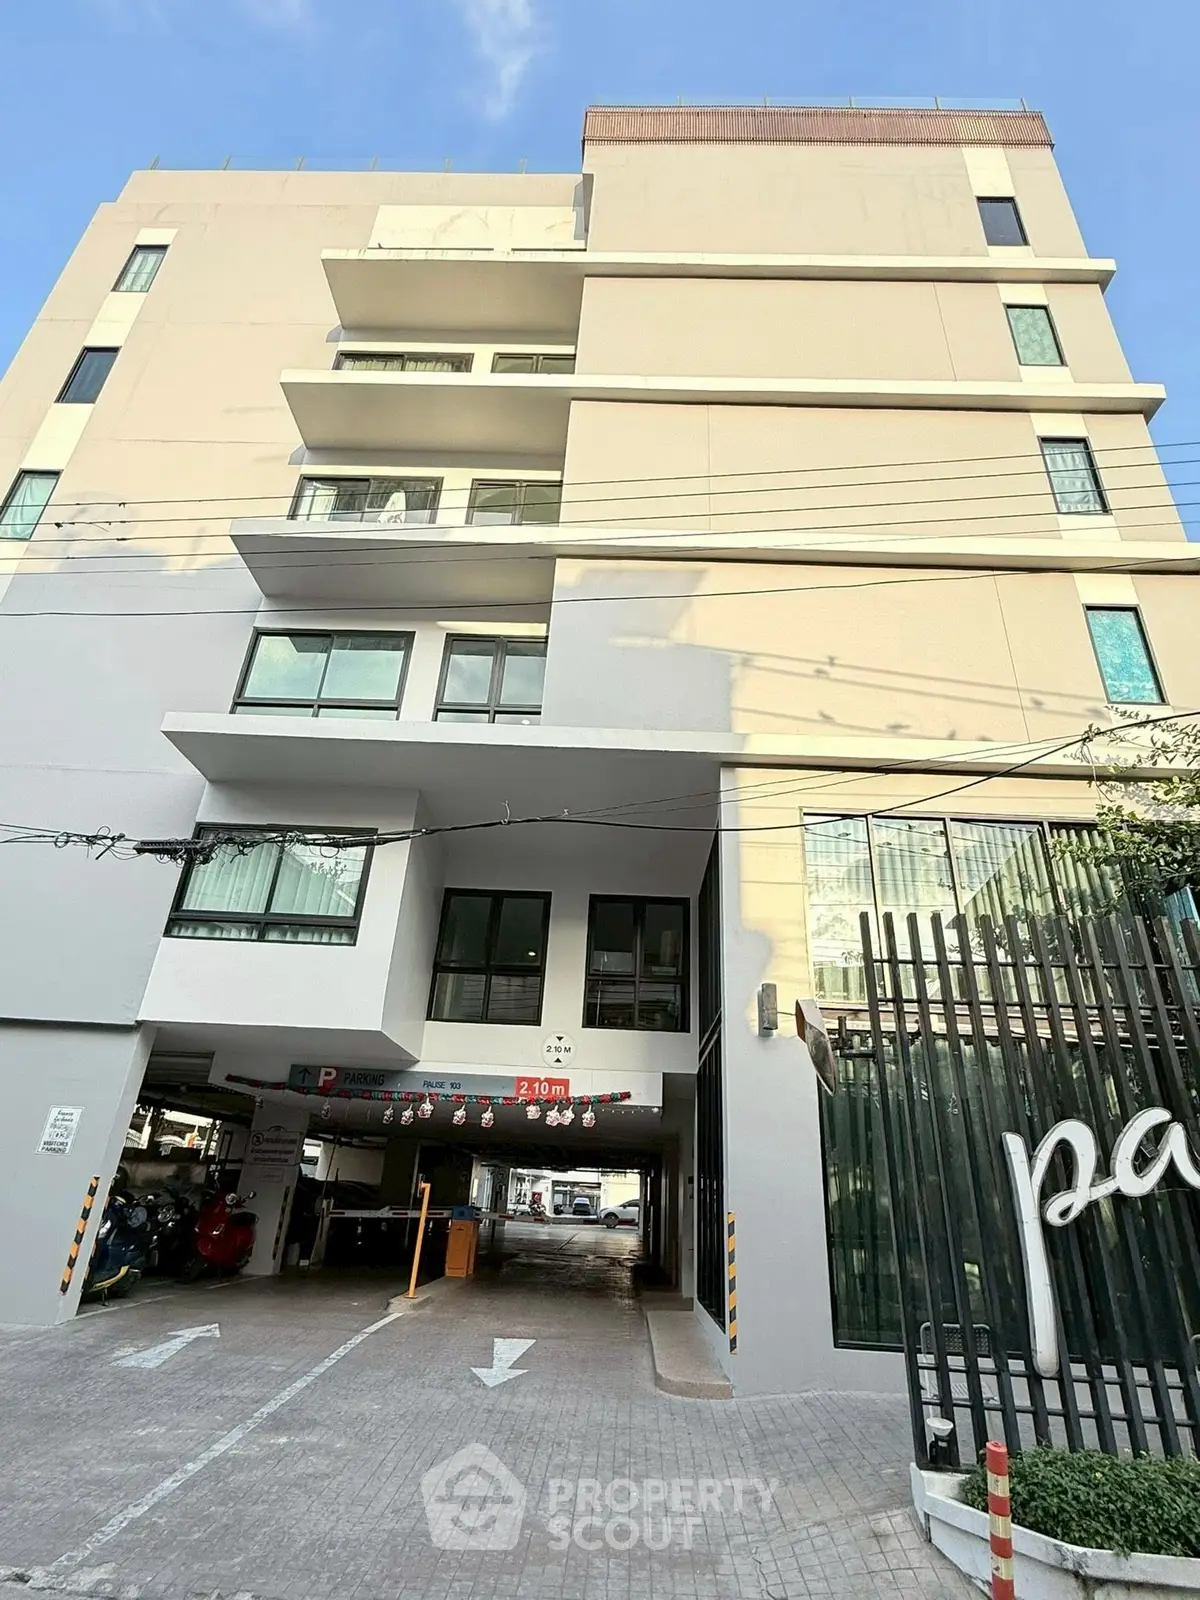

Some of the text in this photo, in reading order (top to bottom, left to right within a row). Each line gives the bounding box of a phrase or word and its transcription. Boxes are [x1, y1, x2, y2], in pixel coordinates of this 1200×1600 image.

[546, 1045, 562, 1053] 2.10
[317, 1067, 565, 1095] P PARKING PAUSE 103 2.10 m
[41, 1146, 67, 1154] PARKING
